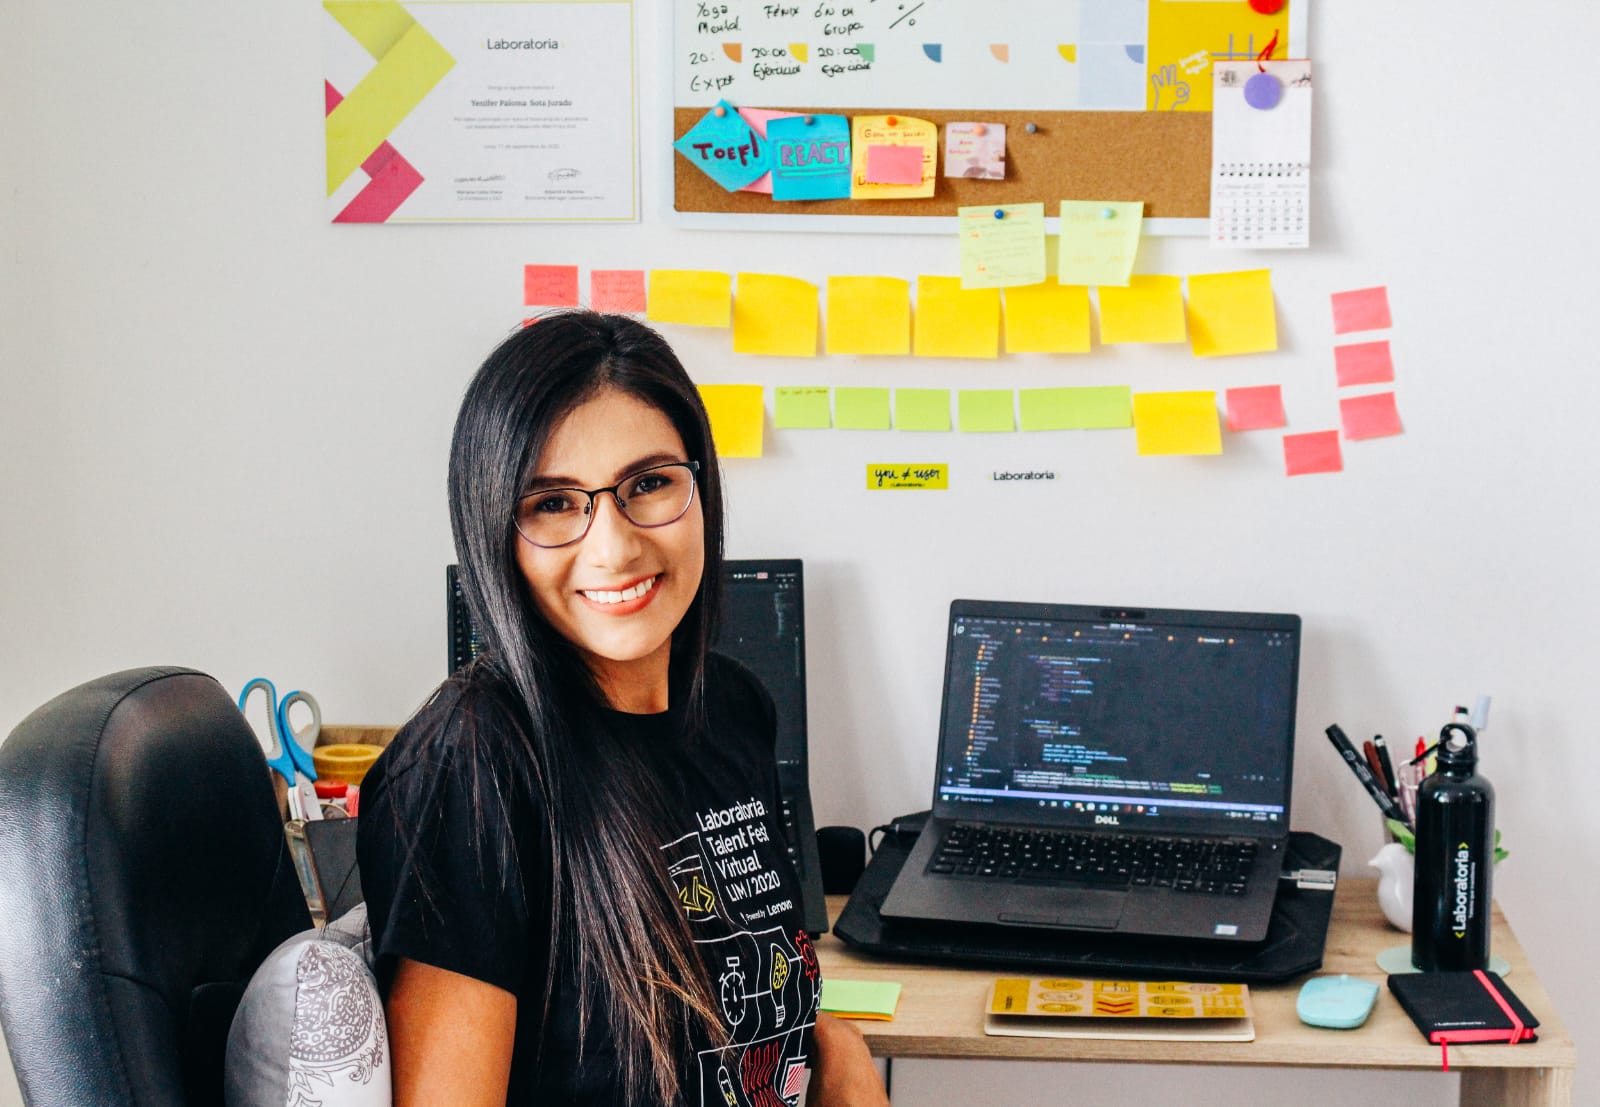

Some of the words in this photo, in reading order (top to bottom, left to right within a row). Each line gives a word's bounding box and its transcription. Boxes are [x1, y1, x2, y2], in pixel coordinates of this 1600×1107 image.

[696, 2, 728, 19] Yoga
[487, 38, 559, 50] Laboratoria
[500, 99, 527, 107] Paloma
[547, 99, 573, 108] Jurado
[779, 141, 849, 168] REACT
[992, 471, 1055, 481] Laboratoria
[696, 797, 766, 832] Laboratoria
[1095, 815, 1120, 825] DELL
[706, 828, 749, 857] Talent
[748, 822, 769, 846] Fest
[715, 850, 762, 879] Virtual
[752, 870, 781, 895] 2020
[1452, 850, 1469, 931] Laboratoria
[766, 899, 793, 917] Lenovo
